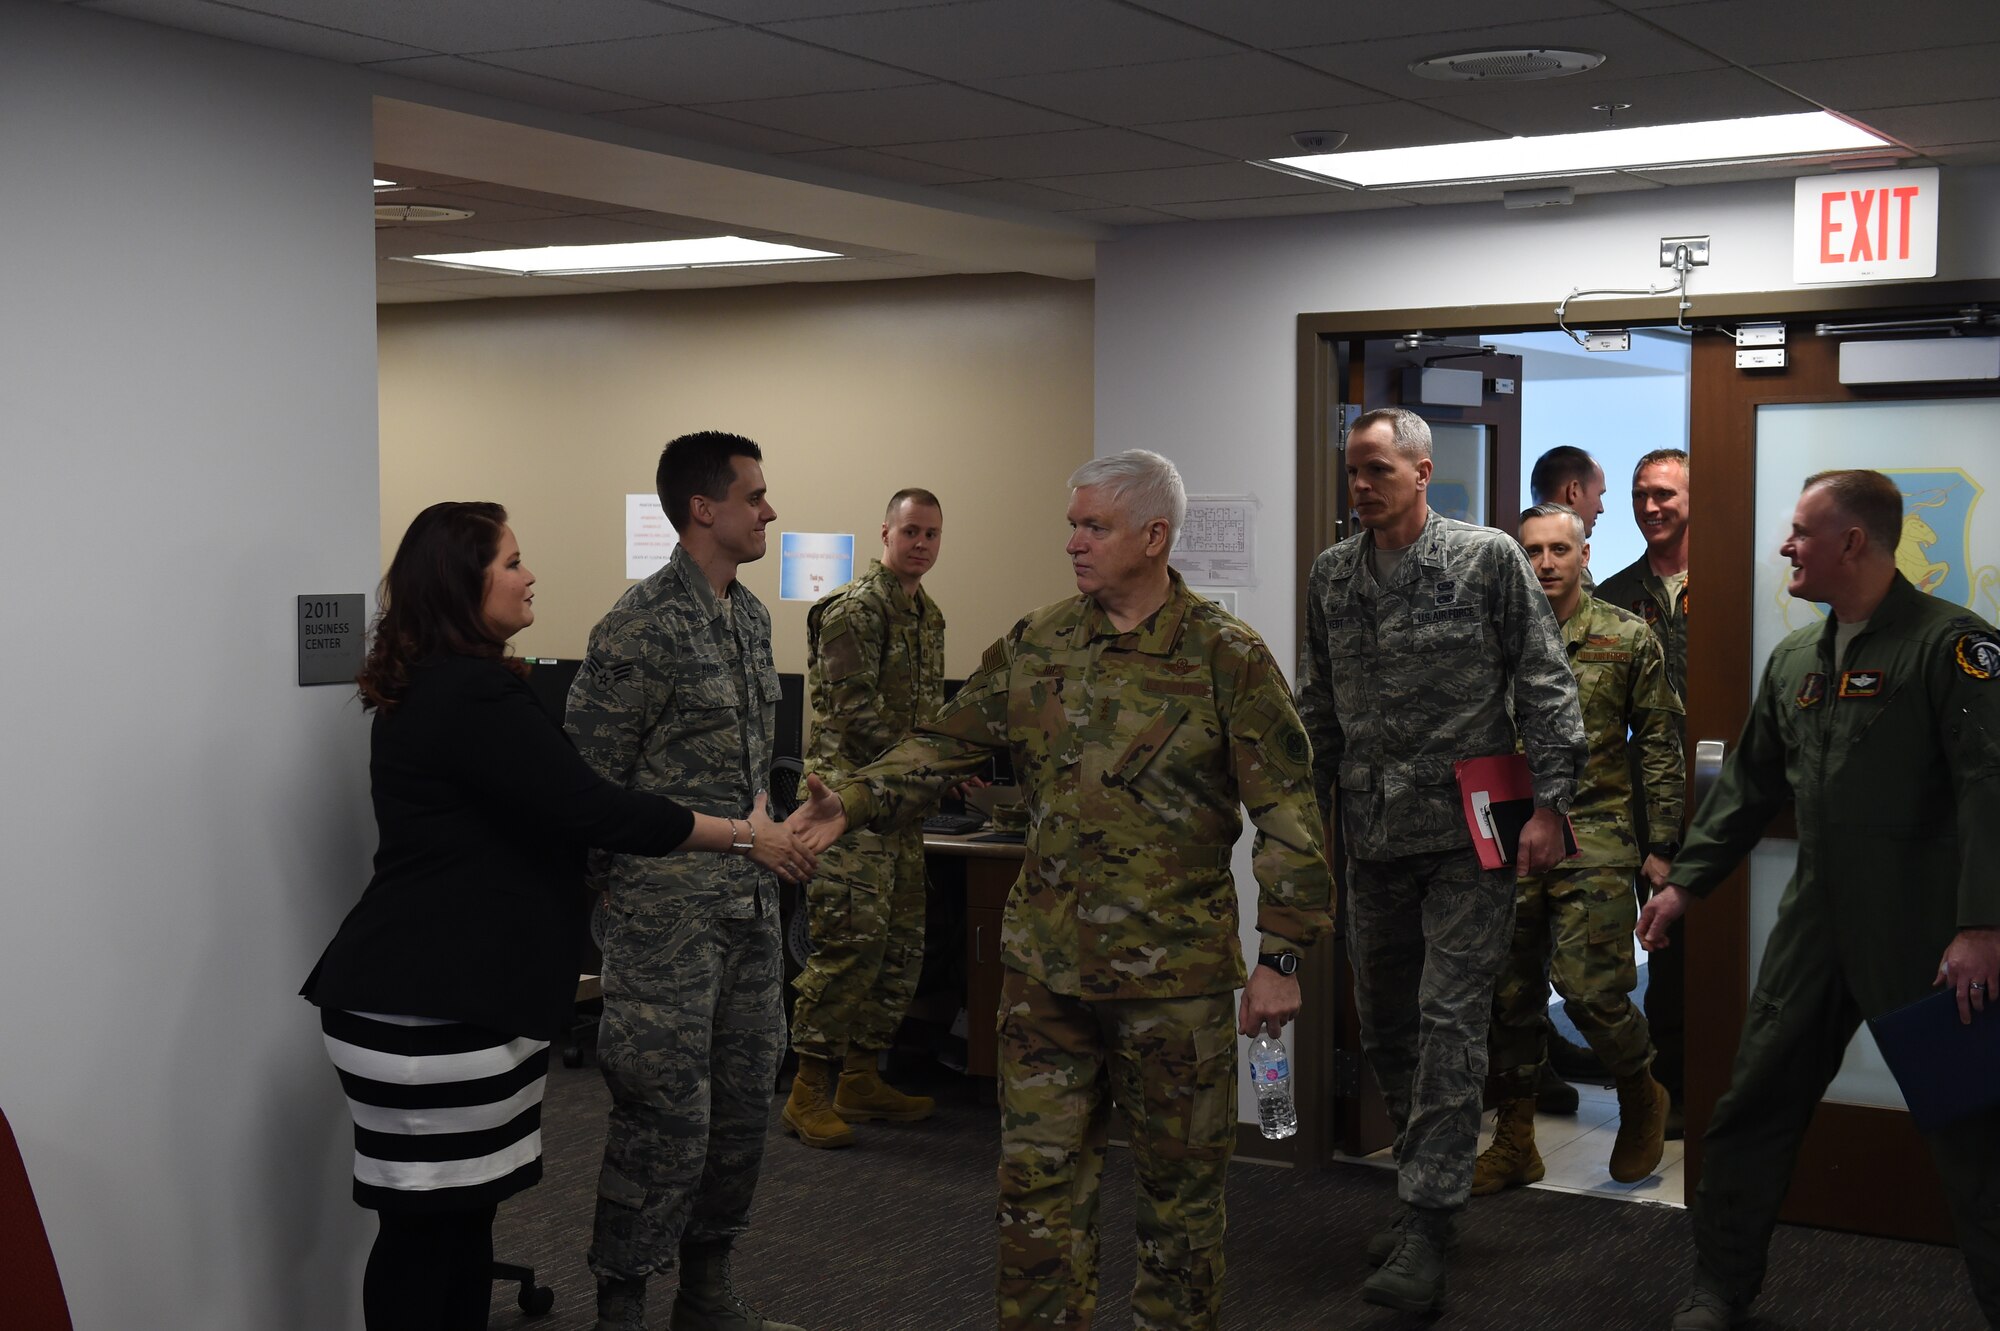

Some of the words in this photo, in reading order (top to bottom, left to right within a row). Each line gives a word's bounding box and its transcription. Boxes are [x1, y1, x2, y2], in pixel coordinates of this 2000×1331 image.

[1820, 186, 1919, 264] EXIT
[304, 601, 339, 619] 2011
[1433, 610, 1447, 621] AIR
[1448, 607, 1475, 619] FORCE
[305, 623, 350, 635] BUSINESS
[305, 638, 341, 650] CENTER
